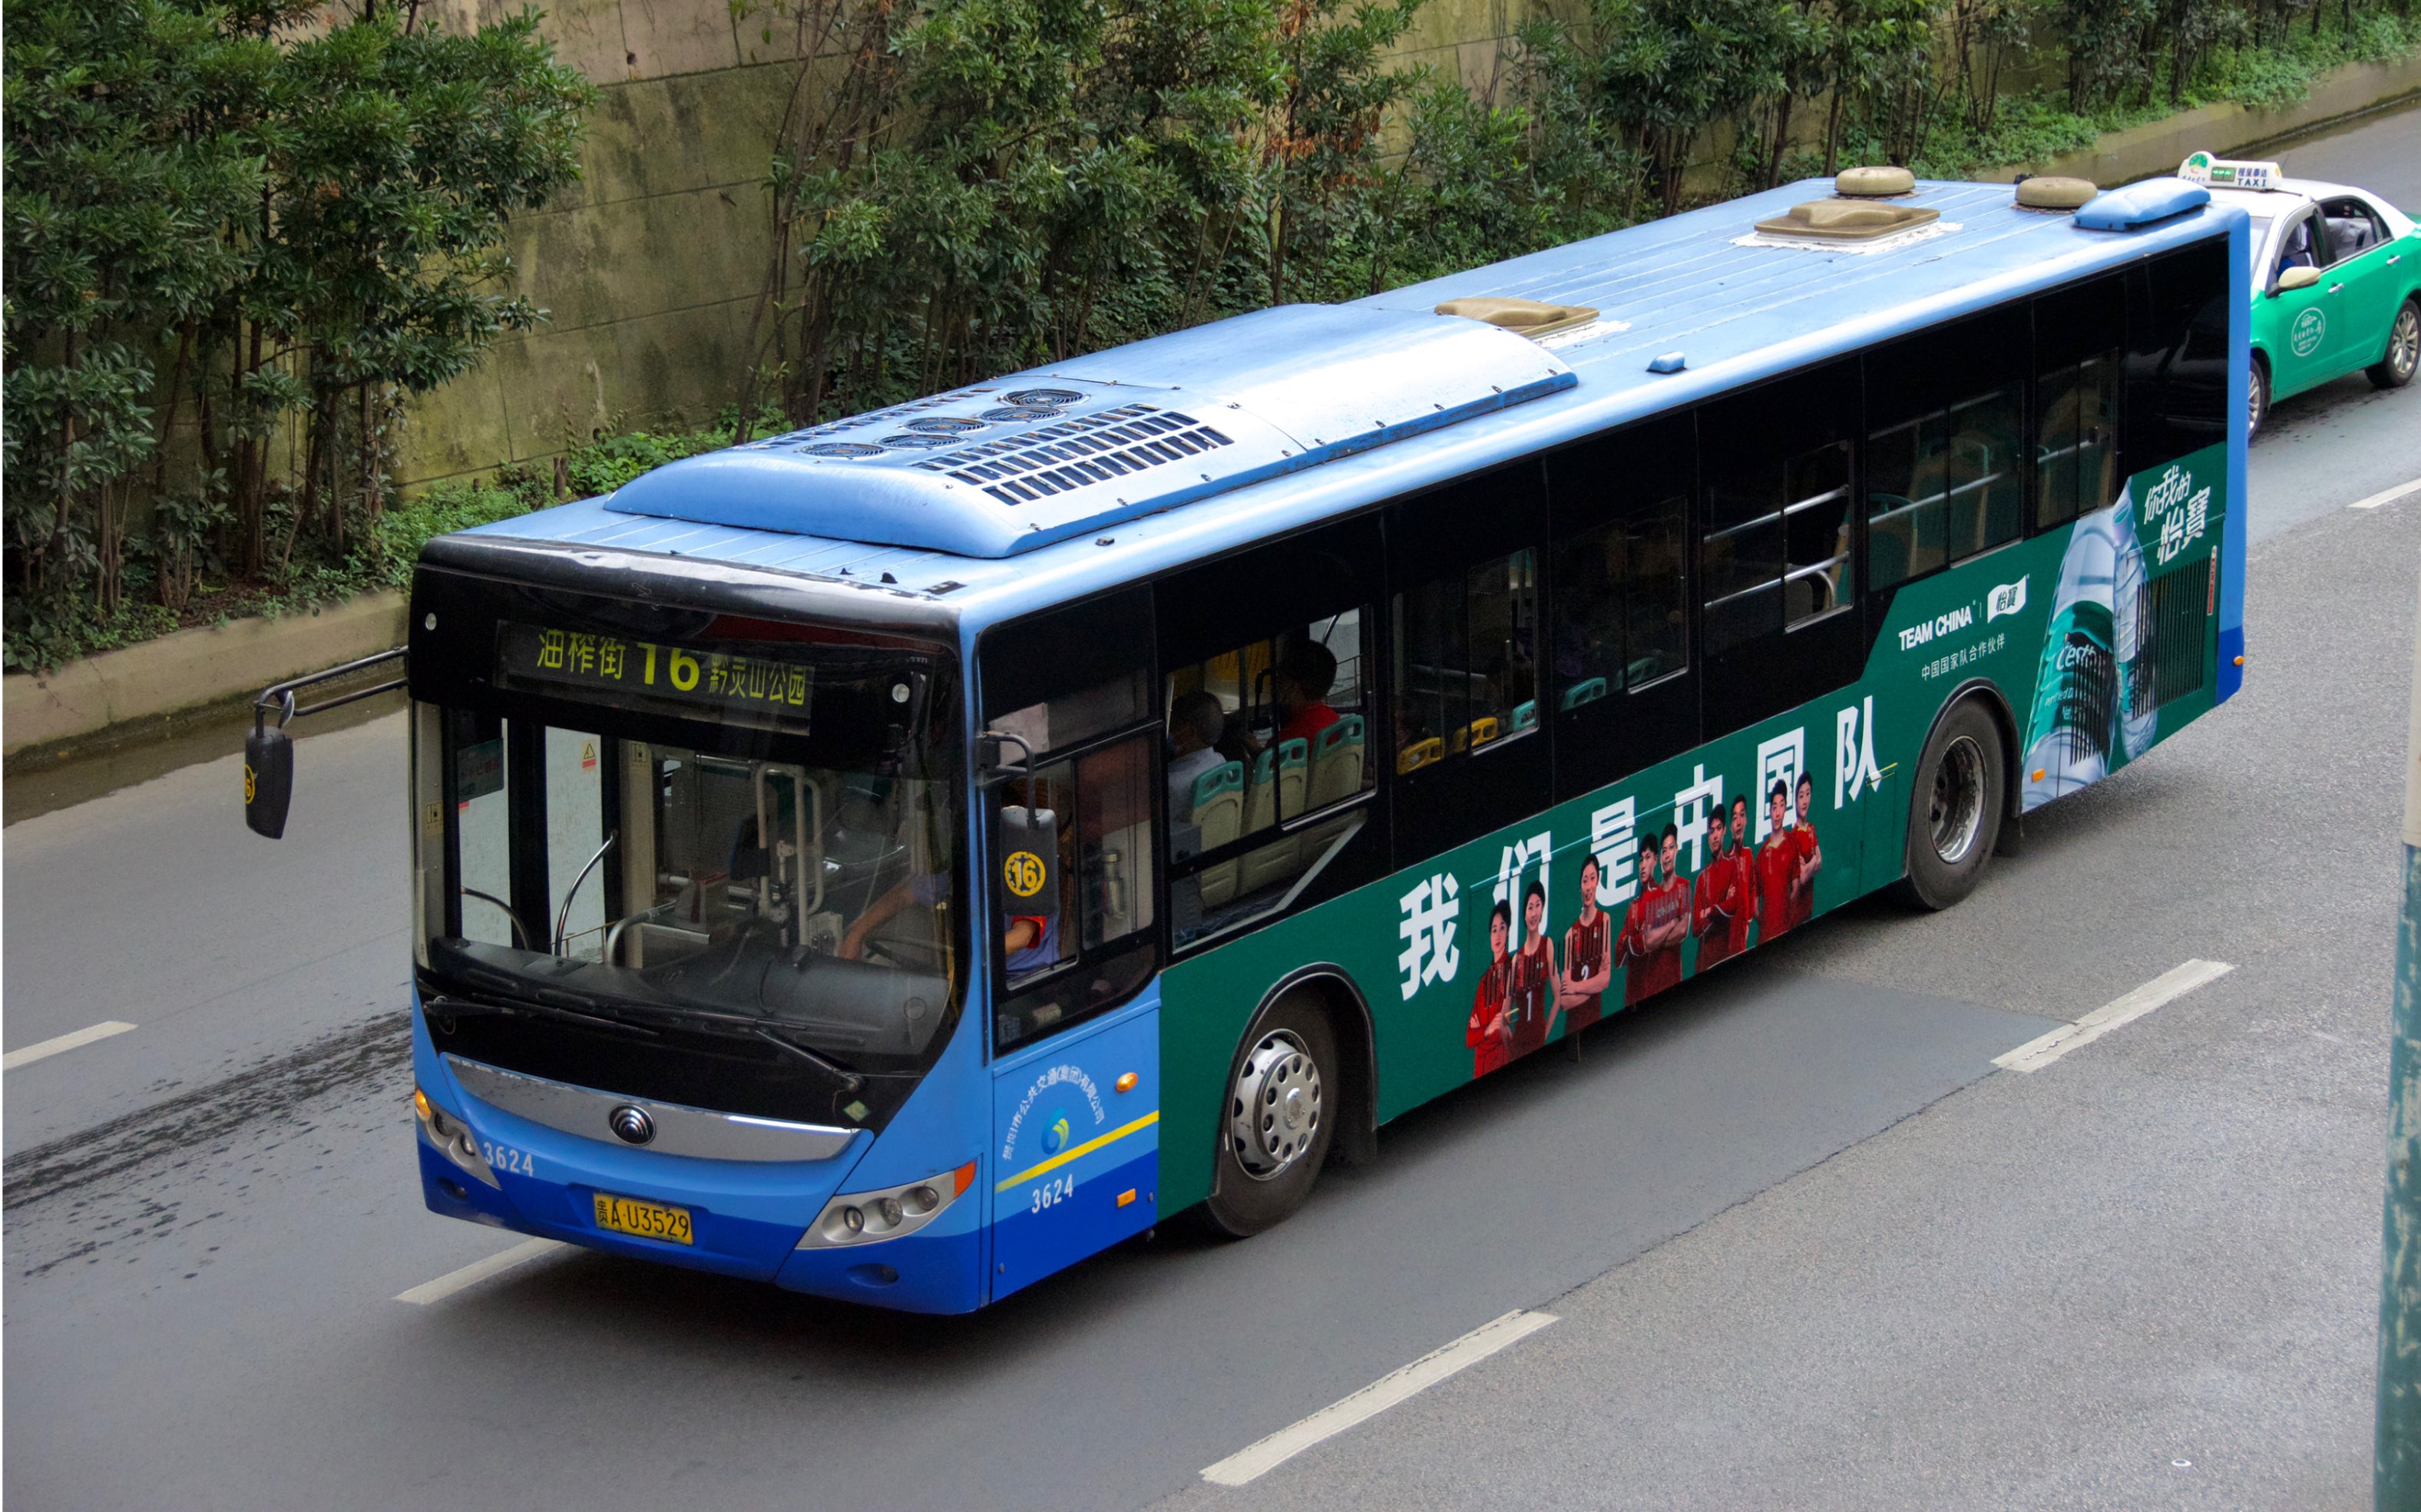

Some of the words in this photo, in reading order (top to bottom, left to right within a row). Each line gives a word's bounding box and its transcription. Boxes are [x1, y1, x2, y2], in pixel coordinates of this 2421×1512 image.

[2237, 178, 2267, 187] TAXI
[2144, 465, 2191, 524] 你我的
[1898, 620, 1933, 651] TEAM
[1935, 605, 1973, 637] CHINA
[537, 628, 627, 680] 油榨街
[637, 641, 700, 692] 16
[1921, 633, 2006, 681] 中国国家队合作伙伴
[1398, 695, 1883, 1001] 我们是中国队
[1012, 859, 1037, 888] 16
[1526, 991, 1533, 1021] 1
[484, 1142, 534, 1177] 3624
[1031, 1173, 1074, 1214] 3624
